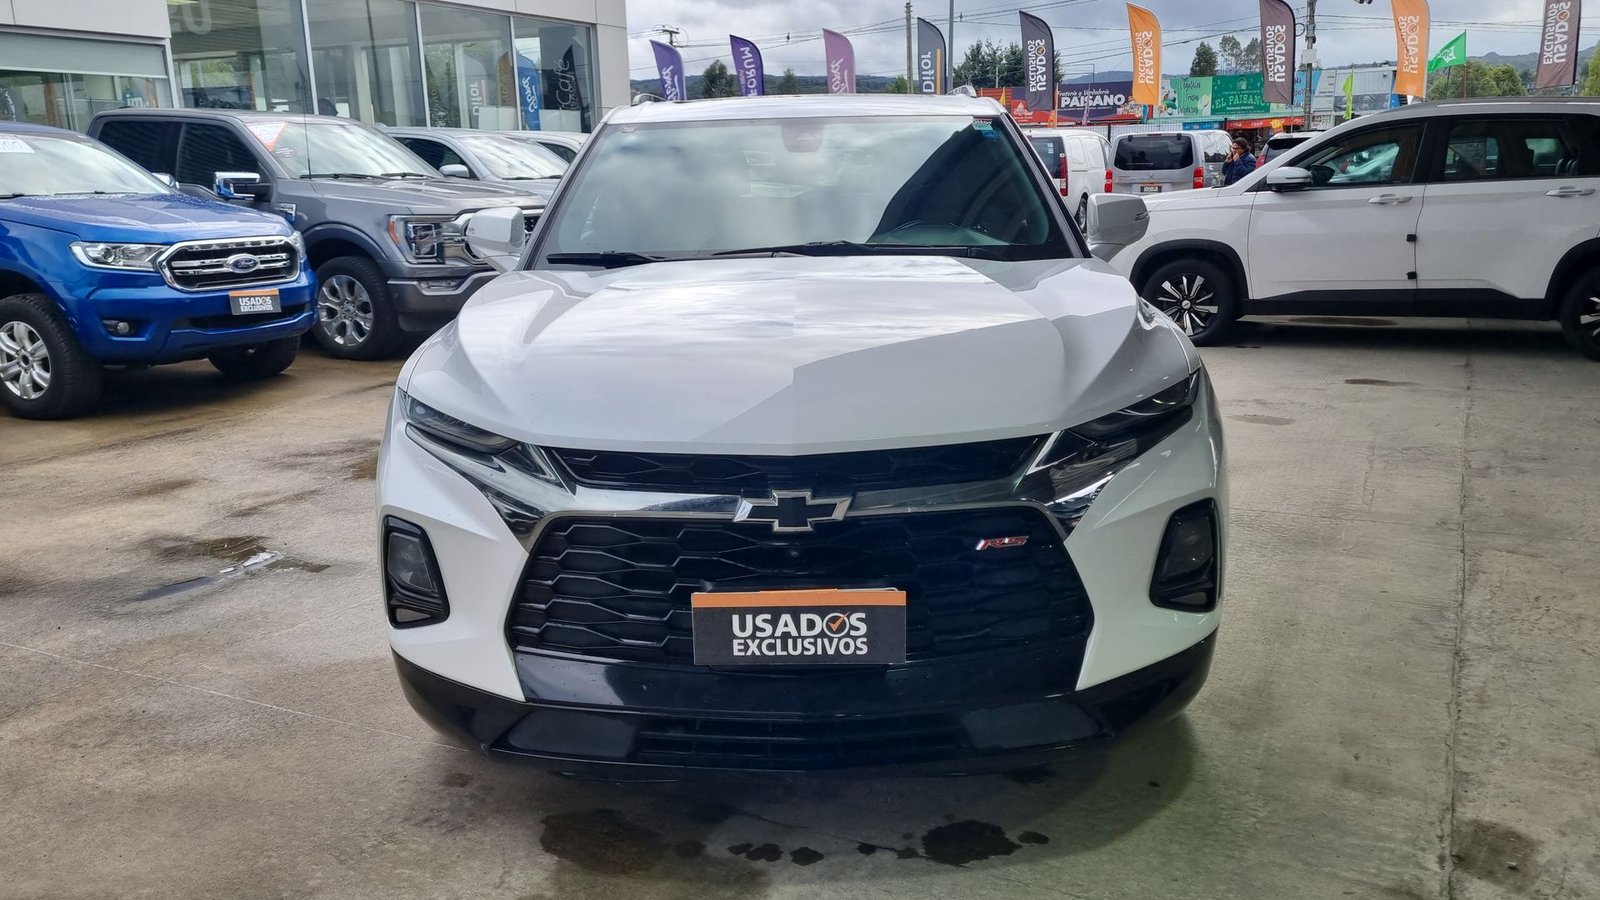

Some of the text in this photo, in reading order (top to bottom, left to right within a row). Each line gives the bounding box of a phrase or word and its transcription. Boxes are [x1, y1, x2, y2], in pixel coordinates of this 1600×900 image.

[1061, 93, 1126, 108] PAISANO
[1215, 94, 1266, 109] EL PAISAN
[239, 296, 272, 306] USADOS
[240, 304, 274, 312] EXCLUSIVOS
[731, 612, 868, 638] USADOS
[732, 637, 869, 657] EXCLUSIVOS
